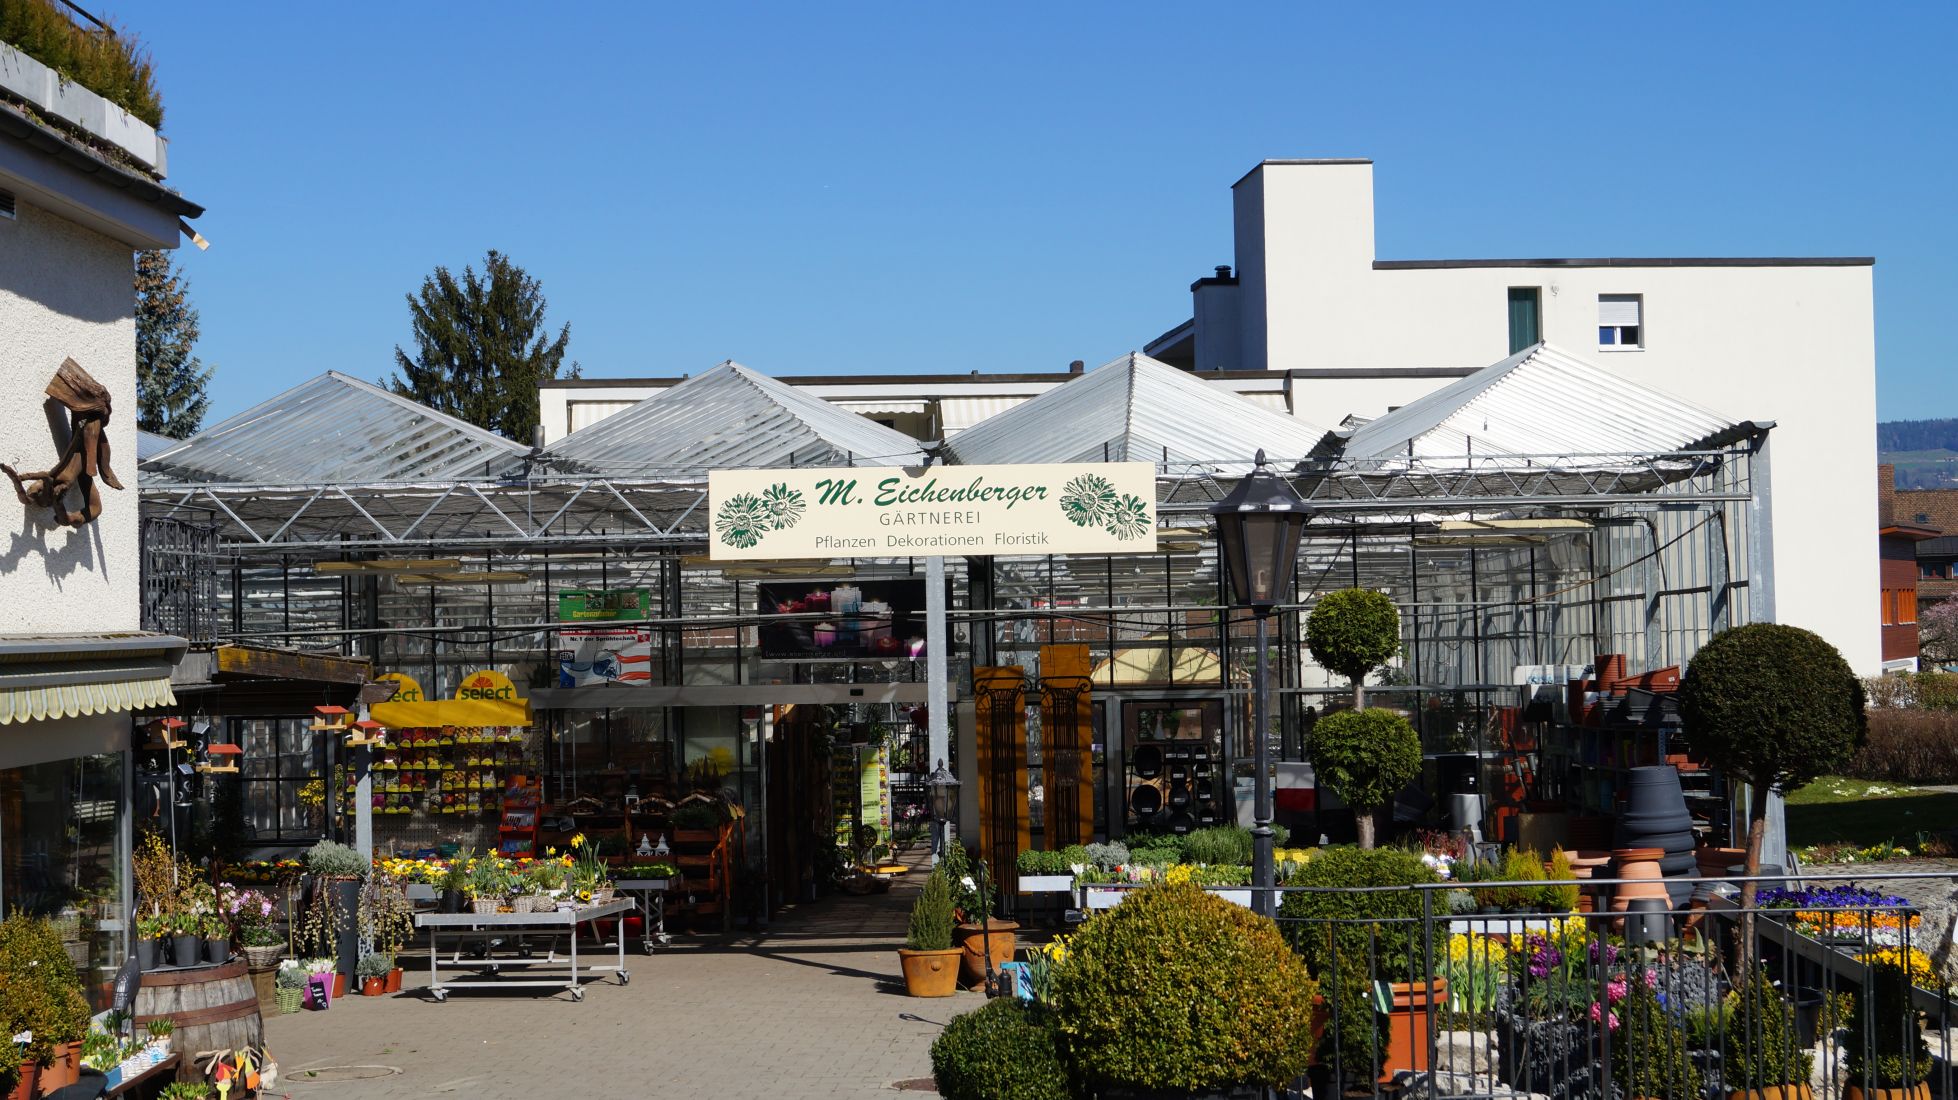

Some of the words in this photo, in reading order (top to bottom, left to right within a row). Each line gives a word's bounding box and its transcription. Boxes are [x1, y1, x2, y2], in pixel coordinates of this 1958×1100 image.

[814, 478, 863, 506] M.
[874, 475, 1049, 512] Eichenberger
[879, 510, 981, 526] GÄRTNEREI
[815, 535, 876, 549] Pflanzen
[886, 533, 984, 547] Dekorationen
[994, 531, 1049, 546] Floristik
[391, 688, 419, 702] ect
[460, 684, 513, 700] select
